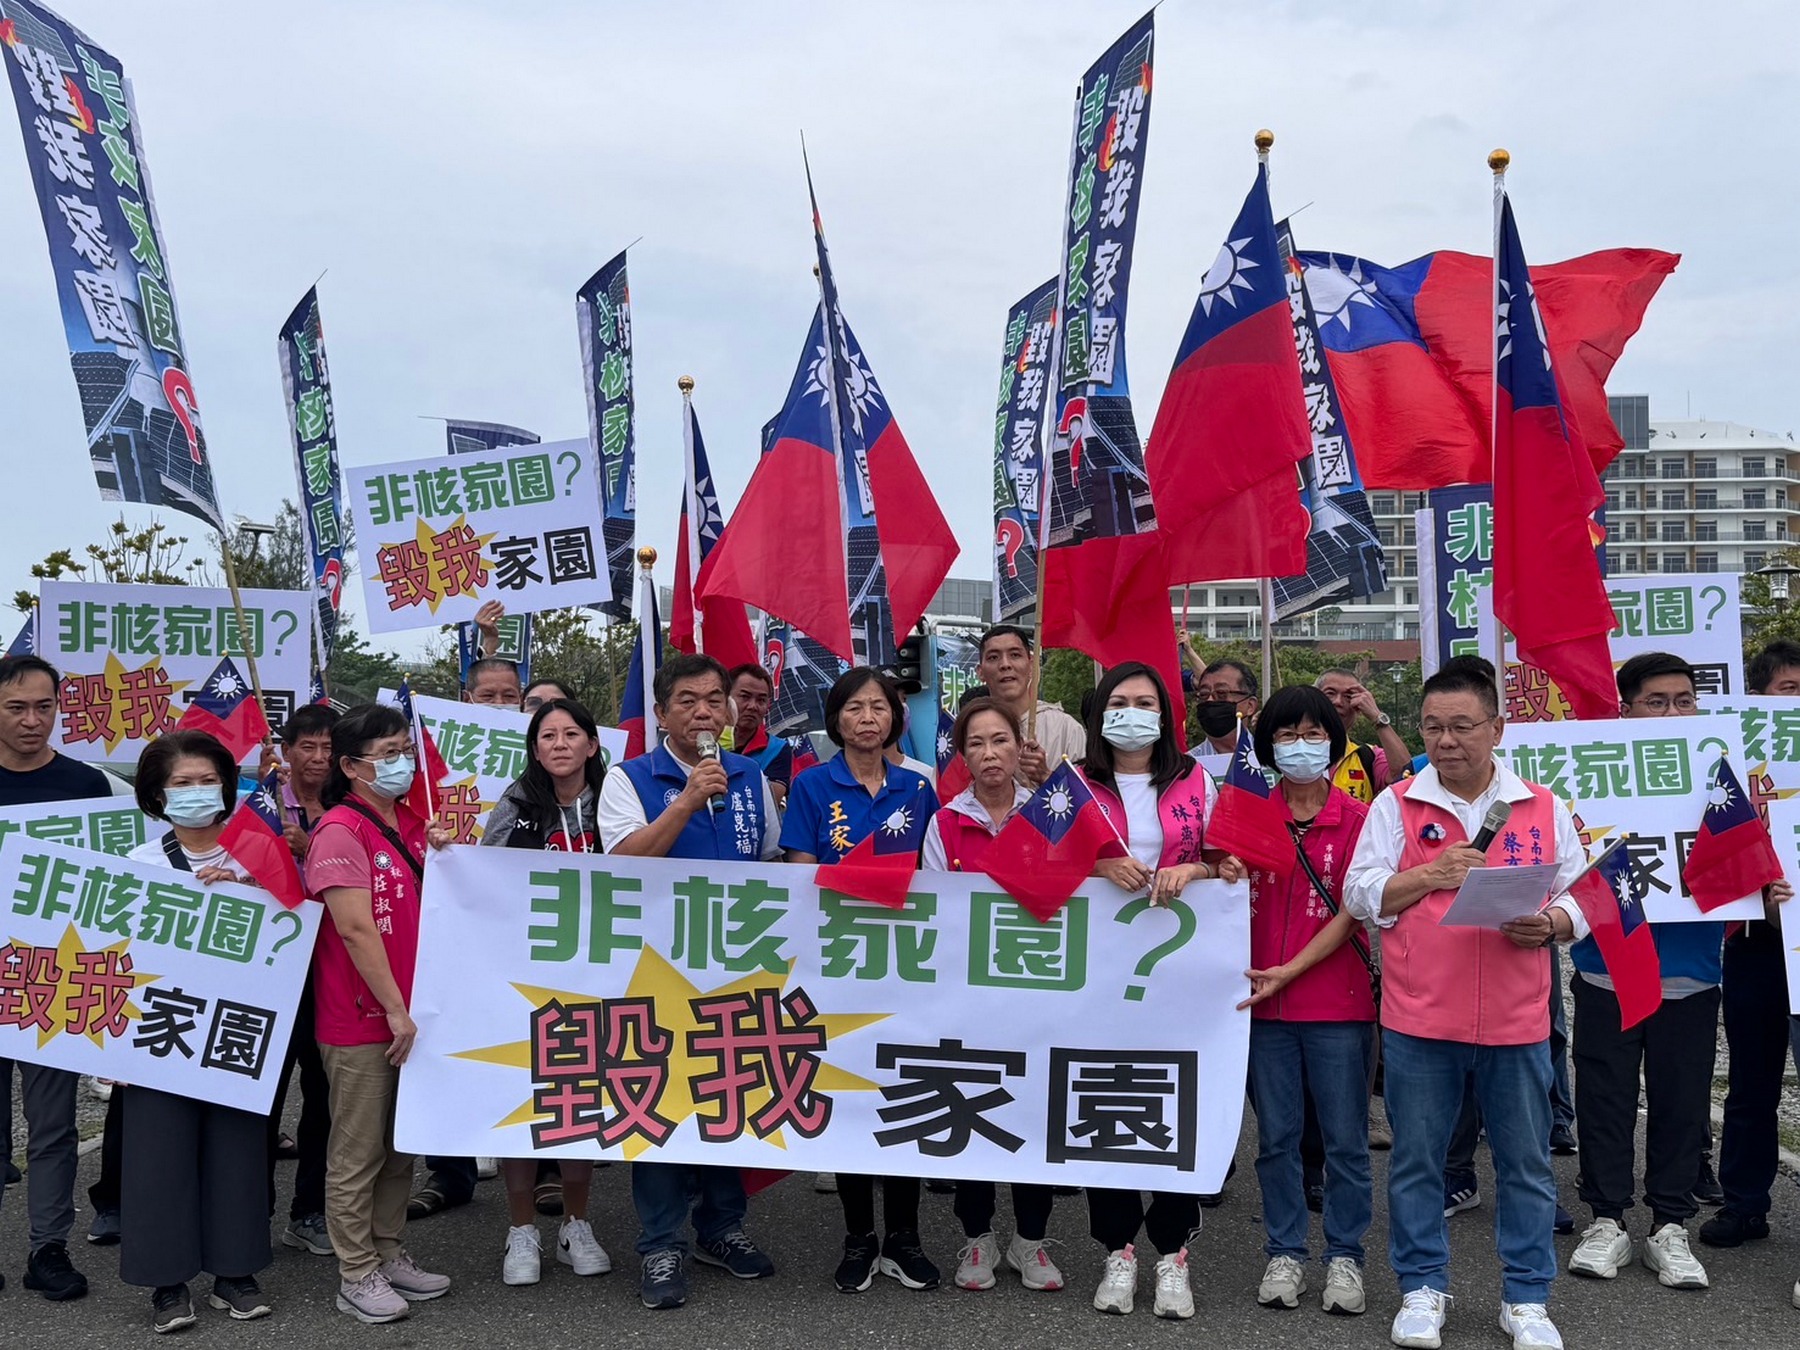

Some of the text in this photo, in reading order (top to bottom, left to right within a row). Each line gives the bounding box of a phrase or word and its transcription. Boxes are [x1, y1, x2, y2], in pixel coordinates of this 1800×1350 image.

[1086, 84, 1145, 389] 毀我家園
[364, 451, 582, 526] 非核家園?
[376, 524, 598, 612] 毀我家園
[58, 601, 298, 658] 非核家園?
[829, 800, 856, 860] 王家
[12, 854, 303, 967] 非核家園?
[528, 868, 1198, 1003] 非核家園?
[0, 942, 278, 1081] 毀我家園
[529, 985, 1199, 1172] 毀我家園
